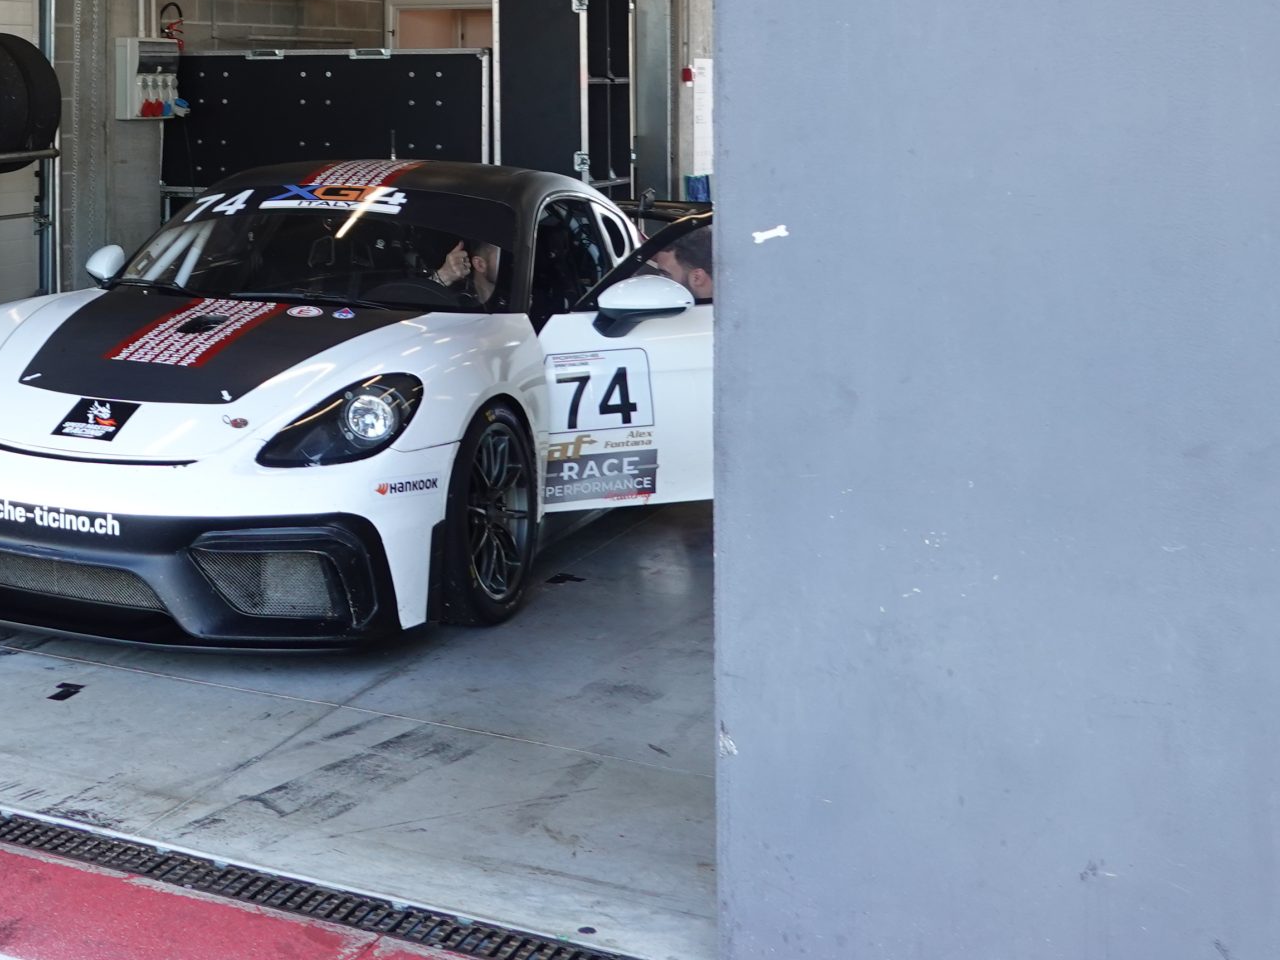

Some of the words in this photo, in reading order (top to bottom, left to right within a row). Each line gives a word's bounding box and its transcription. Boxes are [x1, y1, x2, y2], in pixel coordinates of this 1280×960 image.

[184, 189, 254, 222] 74
[297, 199, 356, 209] ITALY
[556, 367, 637, 429] 74
[604, 439, 652, 449] Fontana
[626, 431, 652, 441] Alex
[561, 457, 639, 480] RACE
[545, 477, 652, 497] PERFORMANCE
